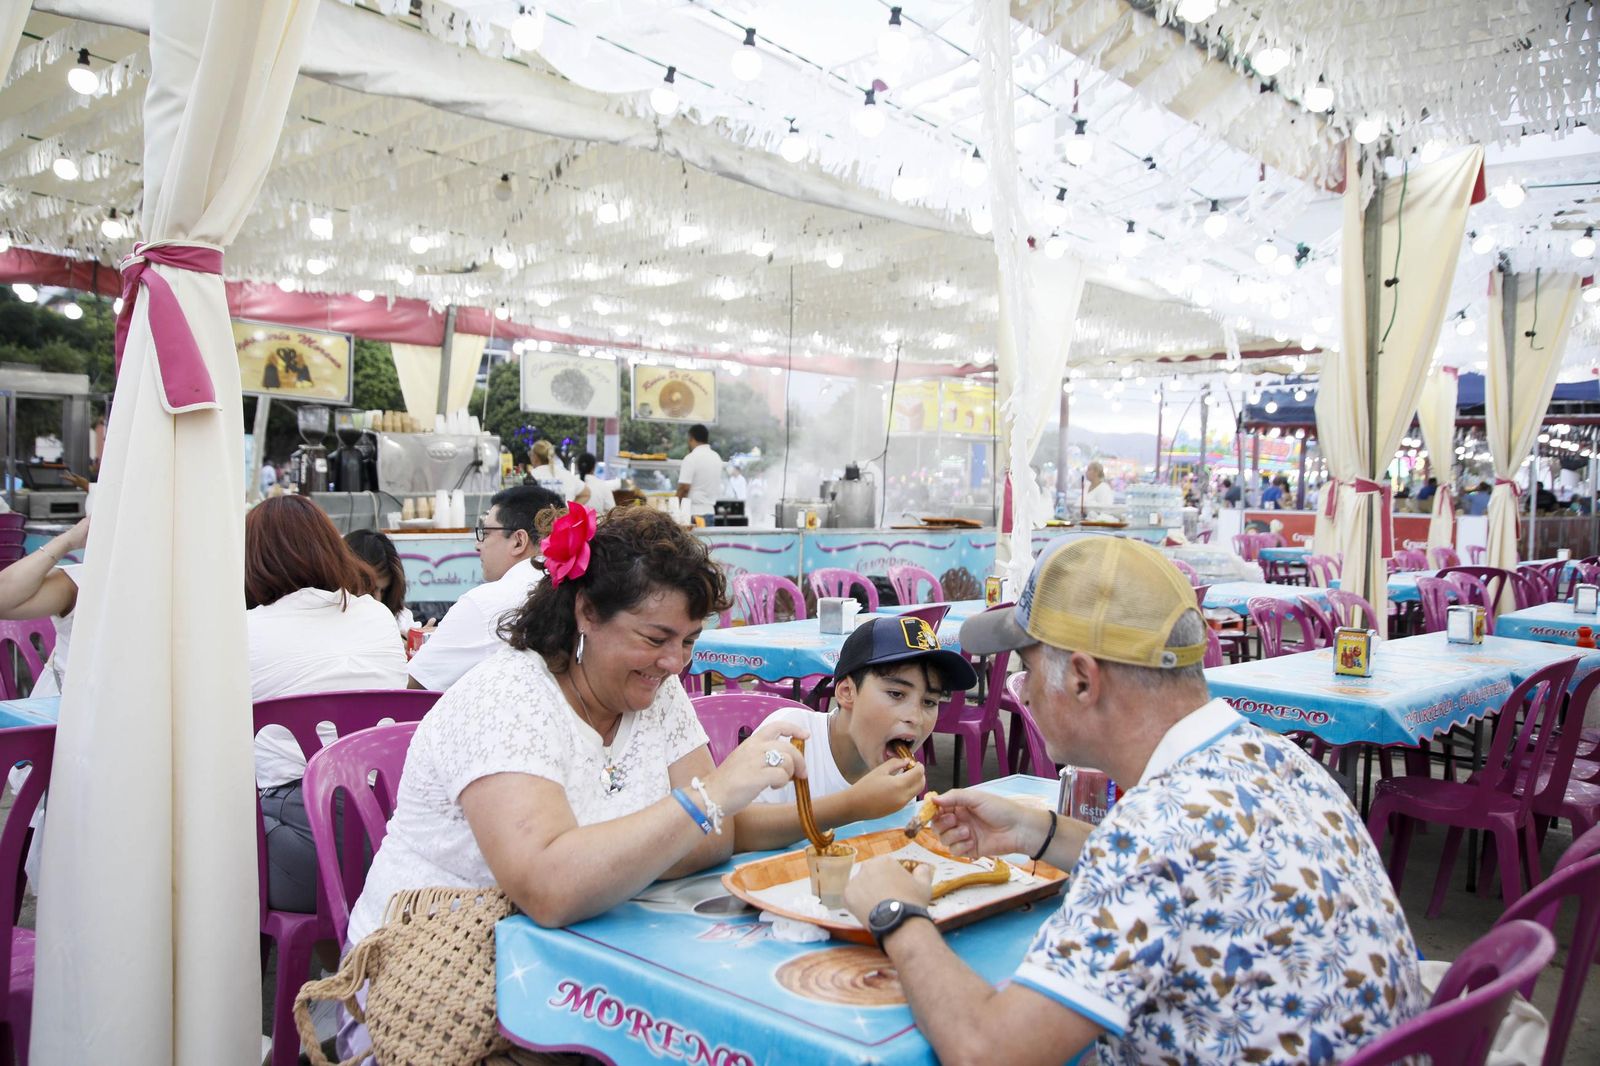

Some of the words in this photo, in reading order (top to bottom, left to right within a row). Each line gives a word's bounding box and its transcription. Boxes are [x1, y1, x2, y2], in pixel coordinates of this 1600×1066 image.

[1529, 626, 1600, 639] MOREO
[694, 651, 763, 668] MORENO
[1222, 697, 1330, 726] MORENO
